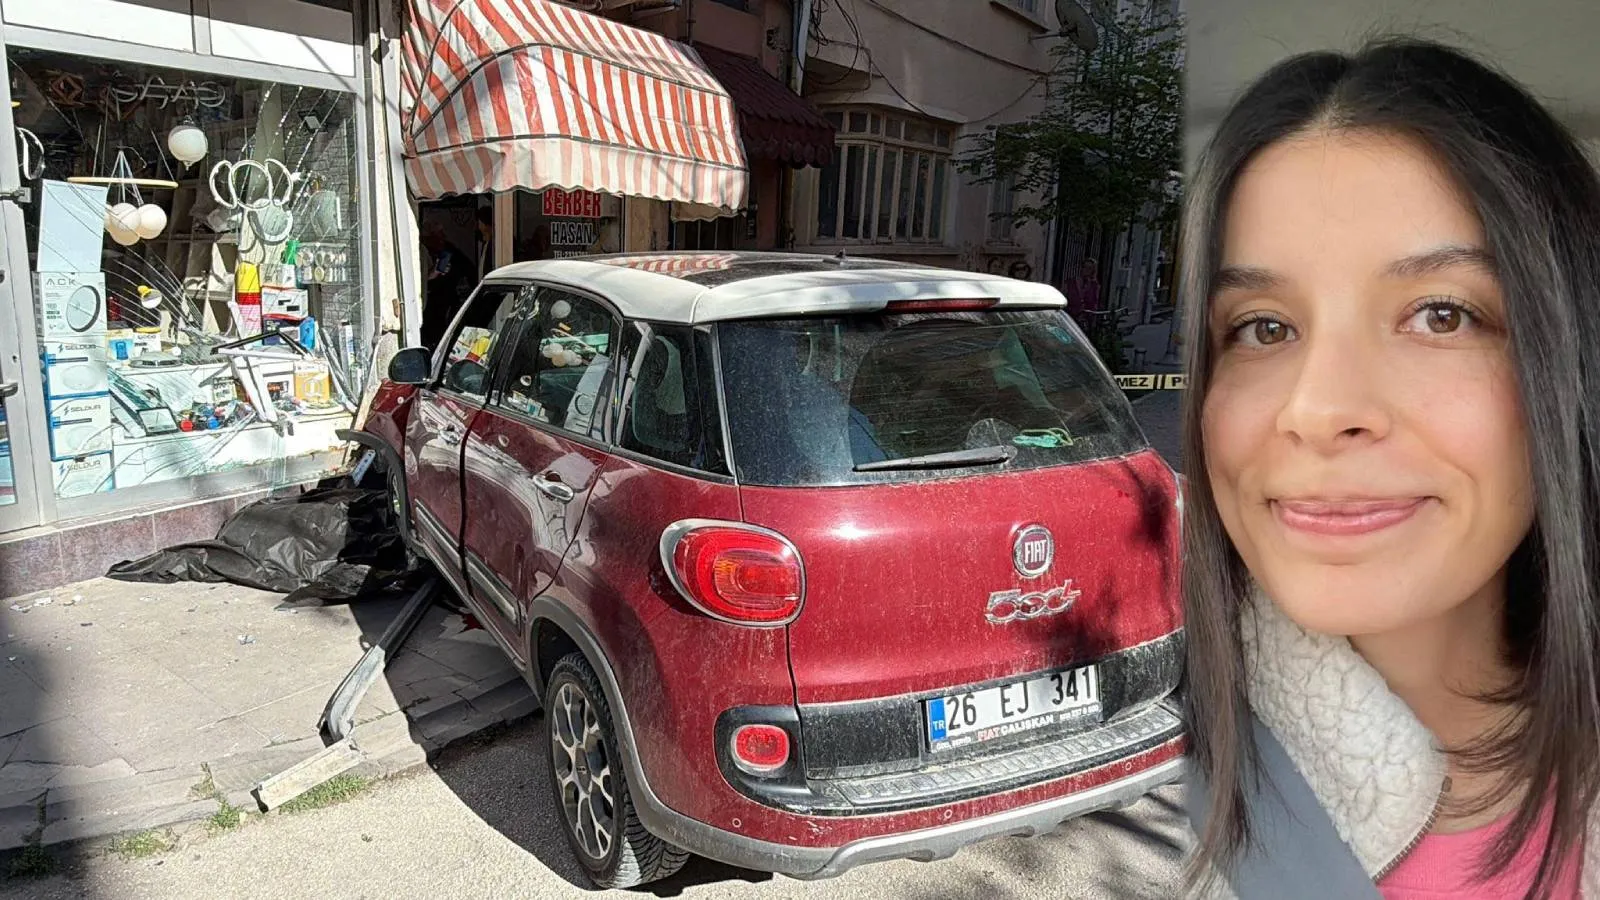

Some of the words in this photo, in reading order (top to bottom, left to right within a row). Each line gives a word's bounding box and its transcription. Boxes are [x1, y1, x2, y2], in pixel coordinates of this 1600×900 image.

[542, 189, 601, 217] BERBER
[551, 222, 593, 245] HASAN
[46, 278, 77, 286] ACK
[1024, 539, 1047, 564] FIAT
[946, 694, 977, 730] 26
[1000, 681, 1029, 718] EJ
[1051, 666, 1093, 705] 341
[932, 720, 946, 731] TR
[977, 727, 1000, 742] FIAT
